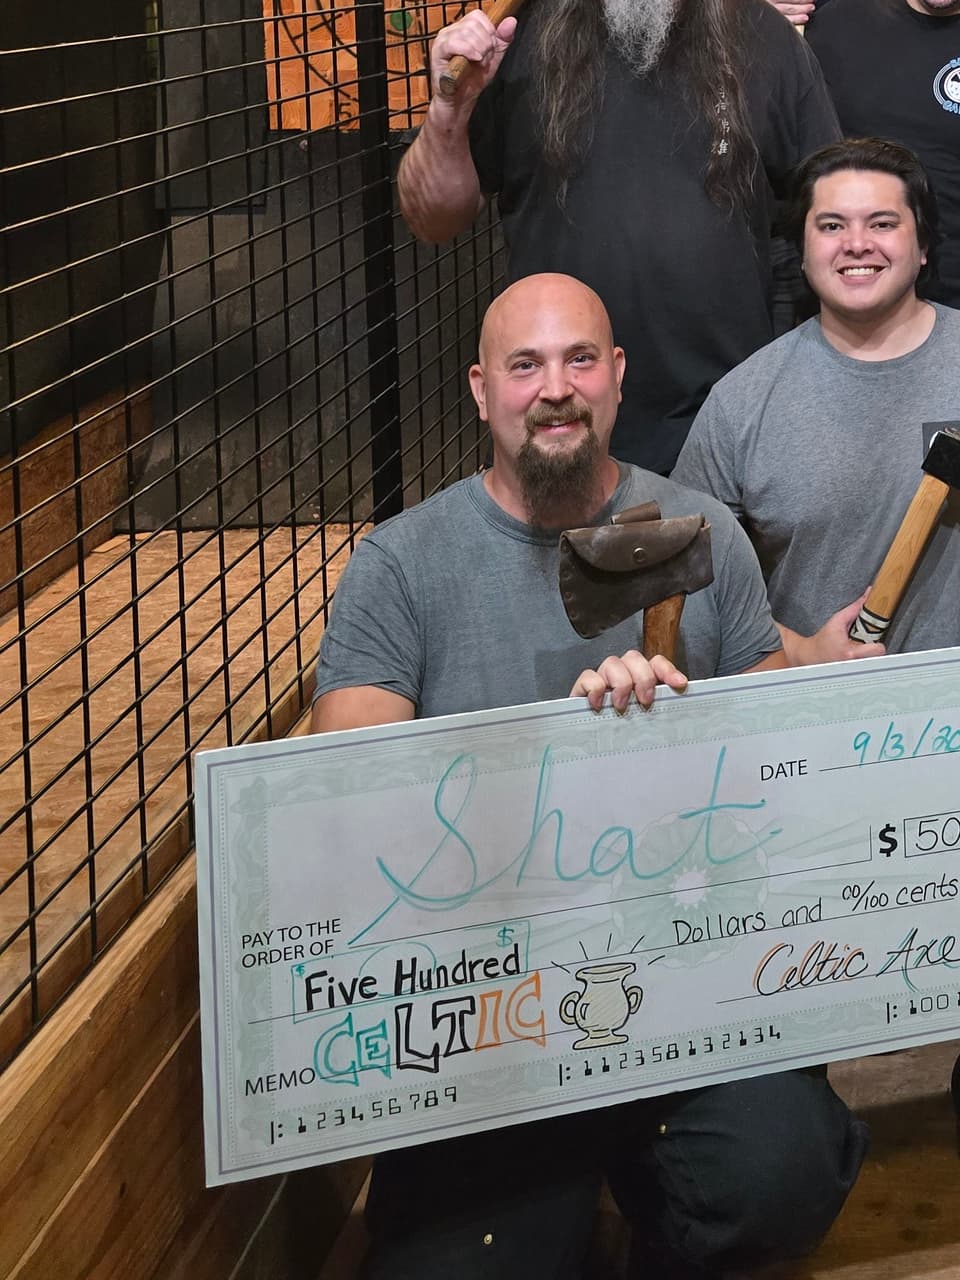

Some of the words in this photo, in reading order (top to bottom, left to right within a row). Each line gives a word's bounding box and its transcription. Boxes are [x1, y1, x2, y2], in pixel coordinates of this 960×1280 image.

[760, 758, 809, 782] DATE
[348, 742, 783, 946] Shat
[878, 823, 899, 858] $
[241, 930, 274, 949] PAY
[277, 925, 303, 943] TO
[305, 918, 342, 937] THE
[304, 970, 379, 1013] Five
[393, 943, 522, 997] Hundred
[672, 909, 767, 946] Dollars
[781, 897, 823, 929] and
[896, 872, 960, 907] cents
[241, 945, 306, 969] ORDER
[309, 939, 335, 956] OF
[752, 939, 870, 997] Celtic
[313, 970, 547, 1088] CELTIC
[244, 1067, 317, 1097] MEMO
